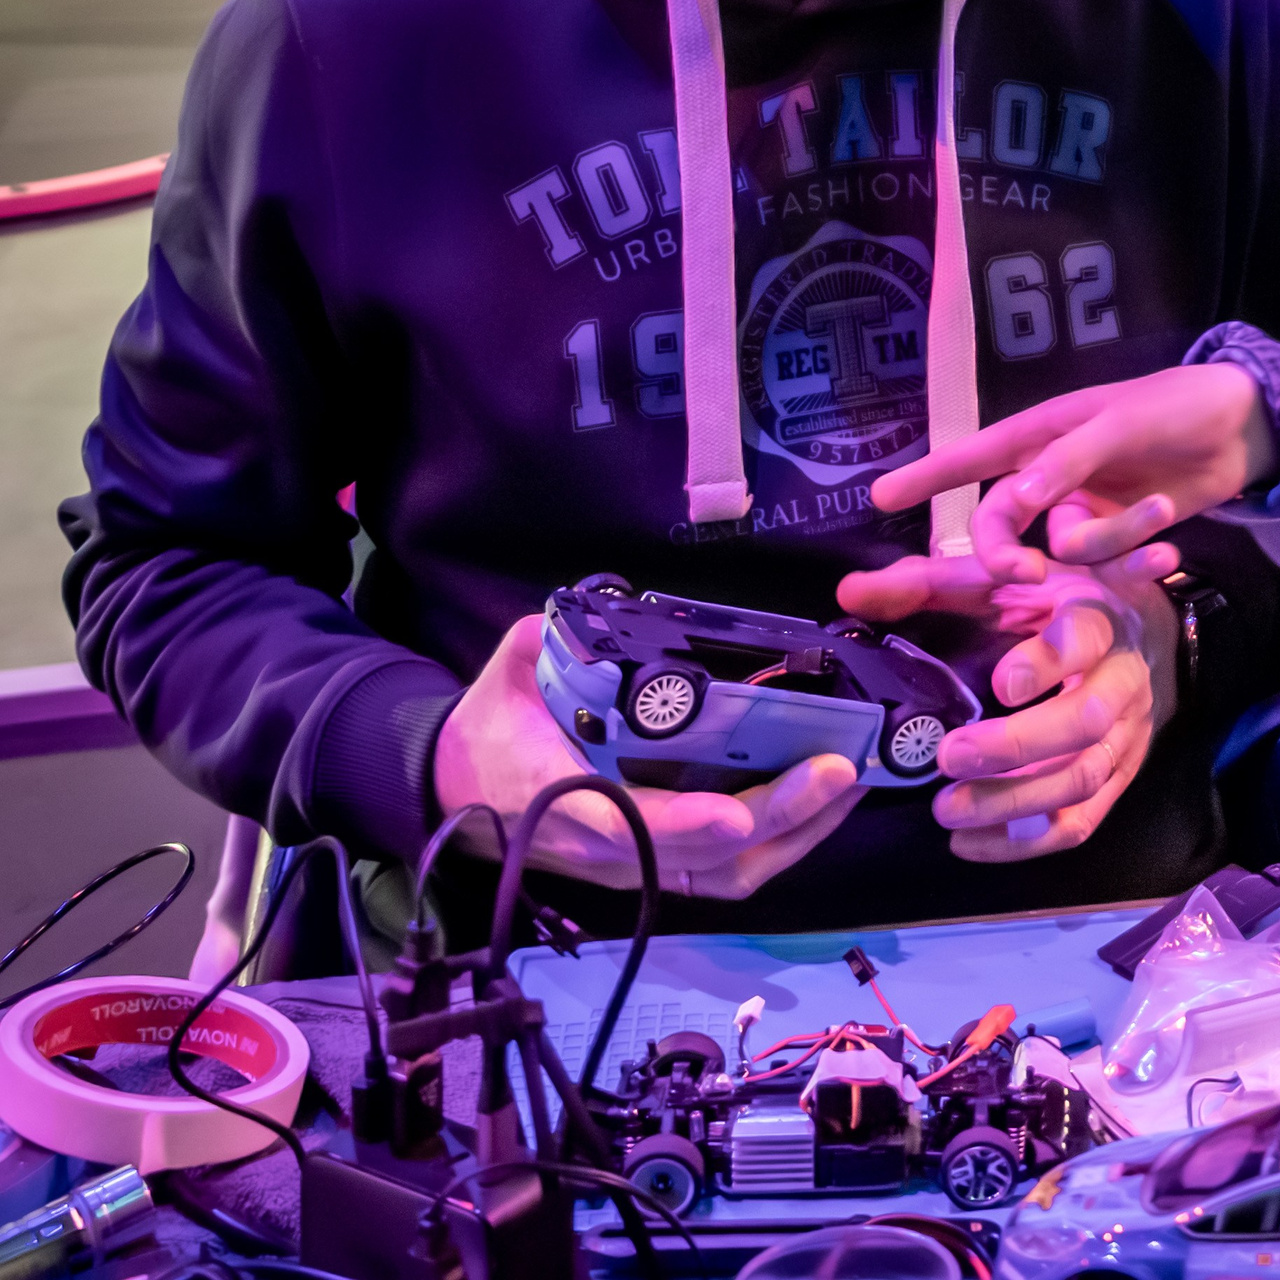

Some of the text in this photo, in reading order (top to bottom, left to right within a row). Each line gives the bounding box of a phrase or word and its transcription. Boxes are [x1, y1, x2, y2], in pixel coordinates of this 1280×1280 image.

[757, 69, 1114, 184] TAILOR
[593, 169, 1053, 283] URB FASHION GEAR
[983, 240, 1122, 361] 62
[562, 306, 687, 433] 19
[775, 343, 832, 381] REG
[872, 330, 920, 365] TM
[784, 407, 858, 437] established
[814, 484, 874, 520] PUR
[90, 995, 198, 1021] NOVAROLL
[136, 1025, 238, 1049] NOVAOLL
